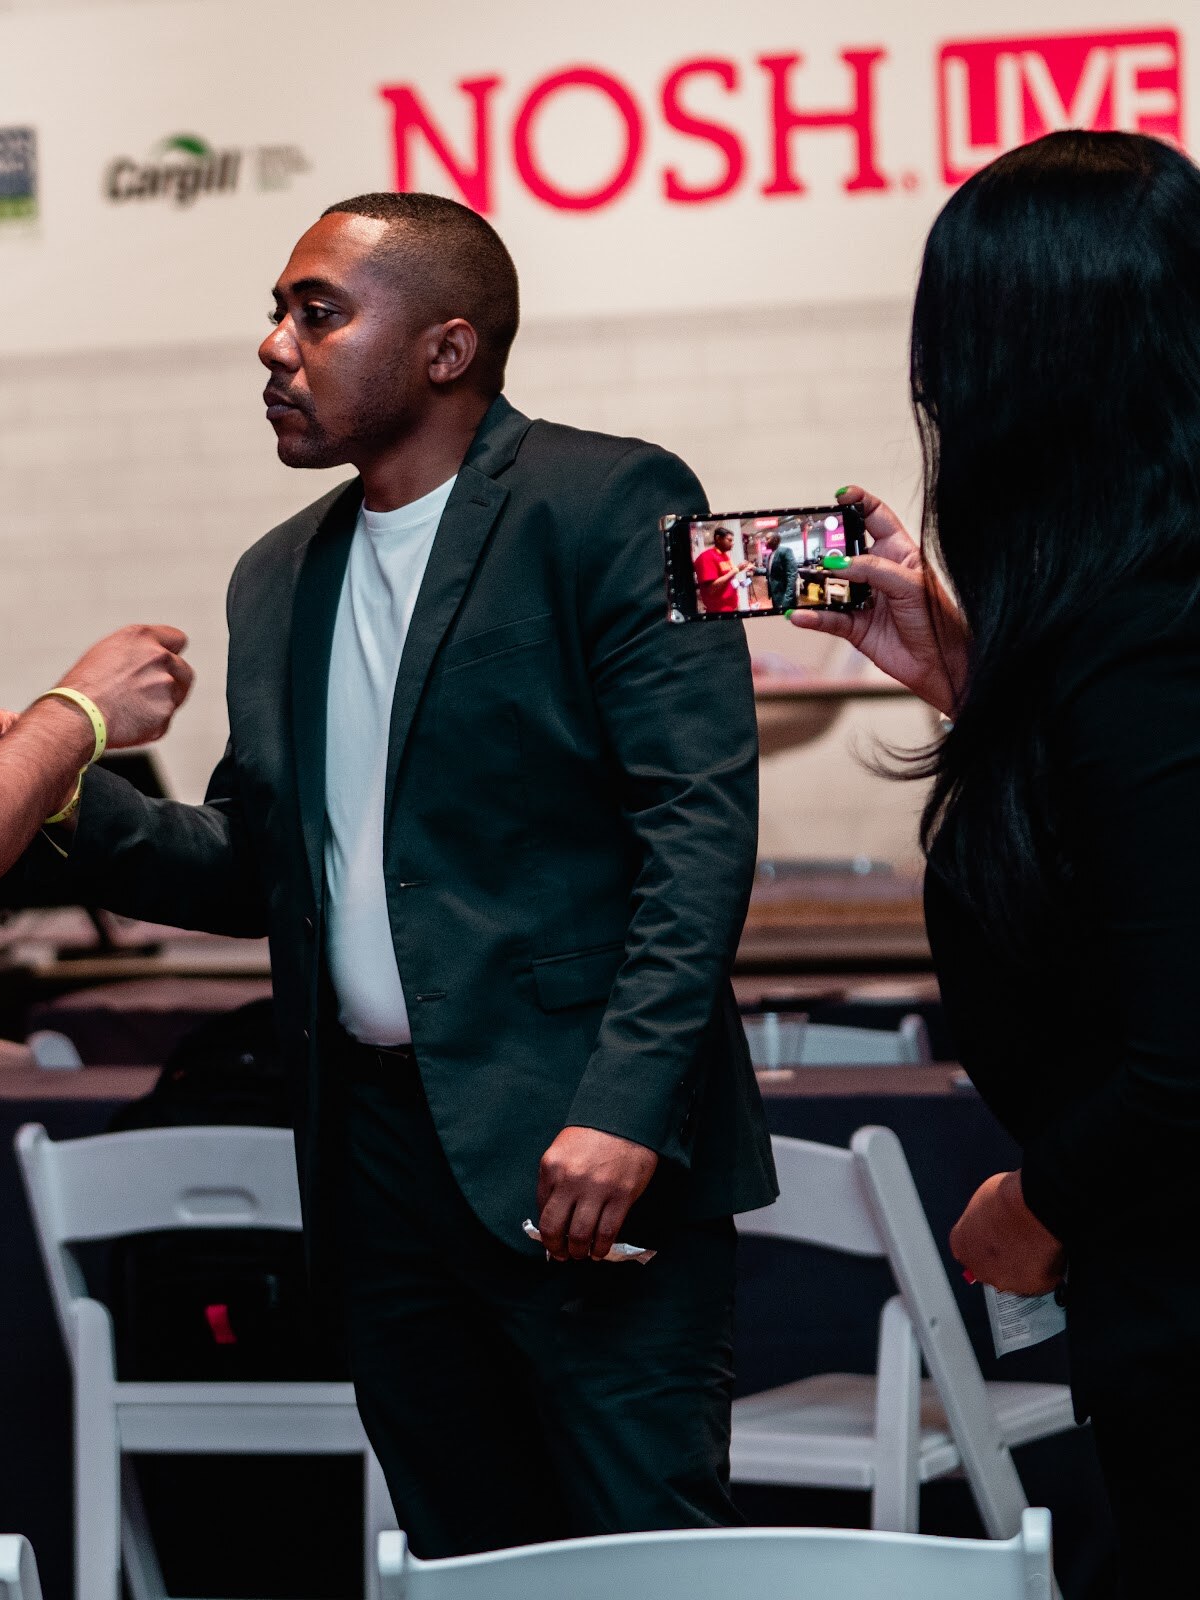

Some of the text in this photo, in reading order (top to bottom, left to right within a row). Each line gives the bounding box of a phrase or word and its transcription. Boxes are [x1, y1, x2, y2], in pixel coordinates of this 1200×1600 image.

[106, 147, 243, 206] Cargill
[380, 42, 1178, 215] NOSH LIVE
